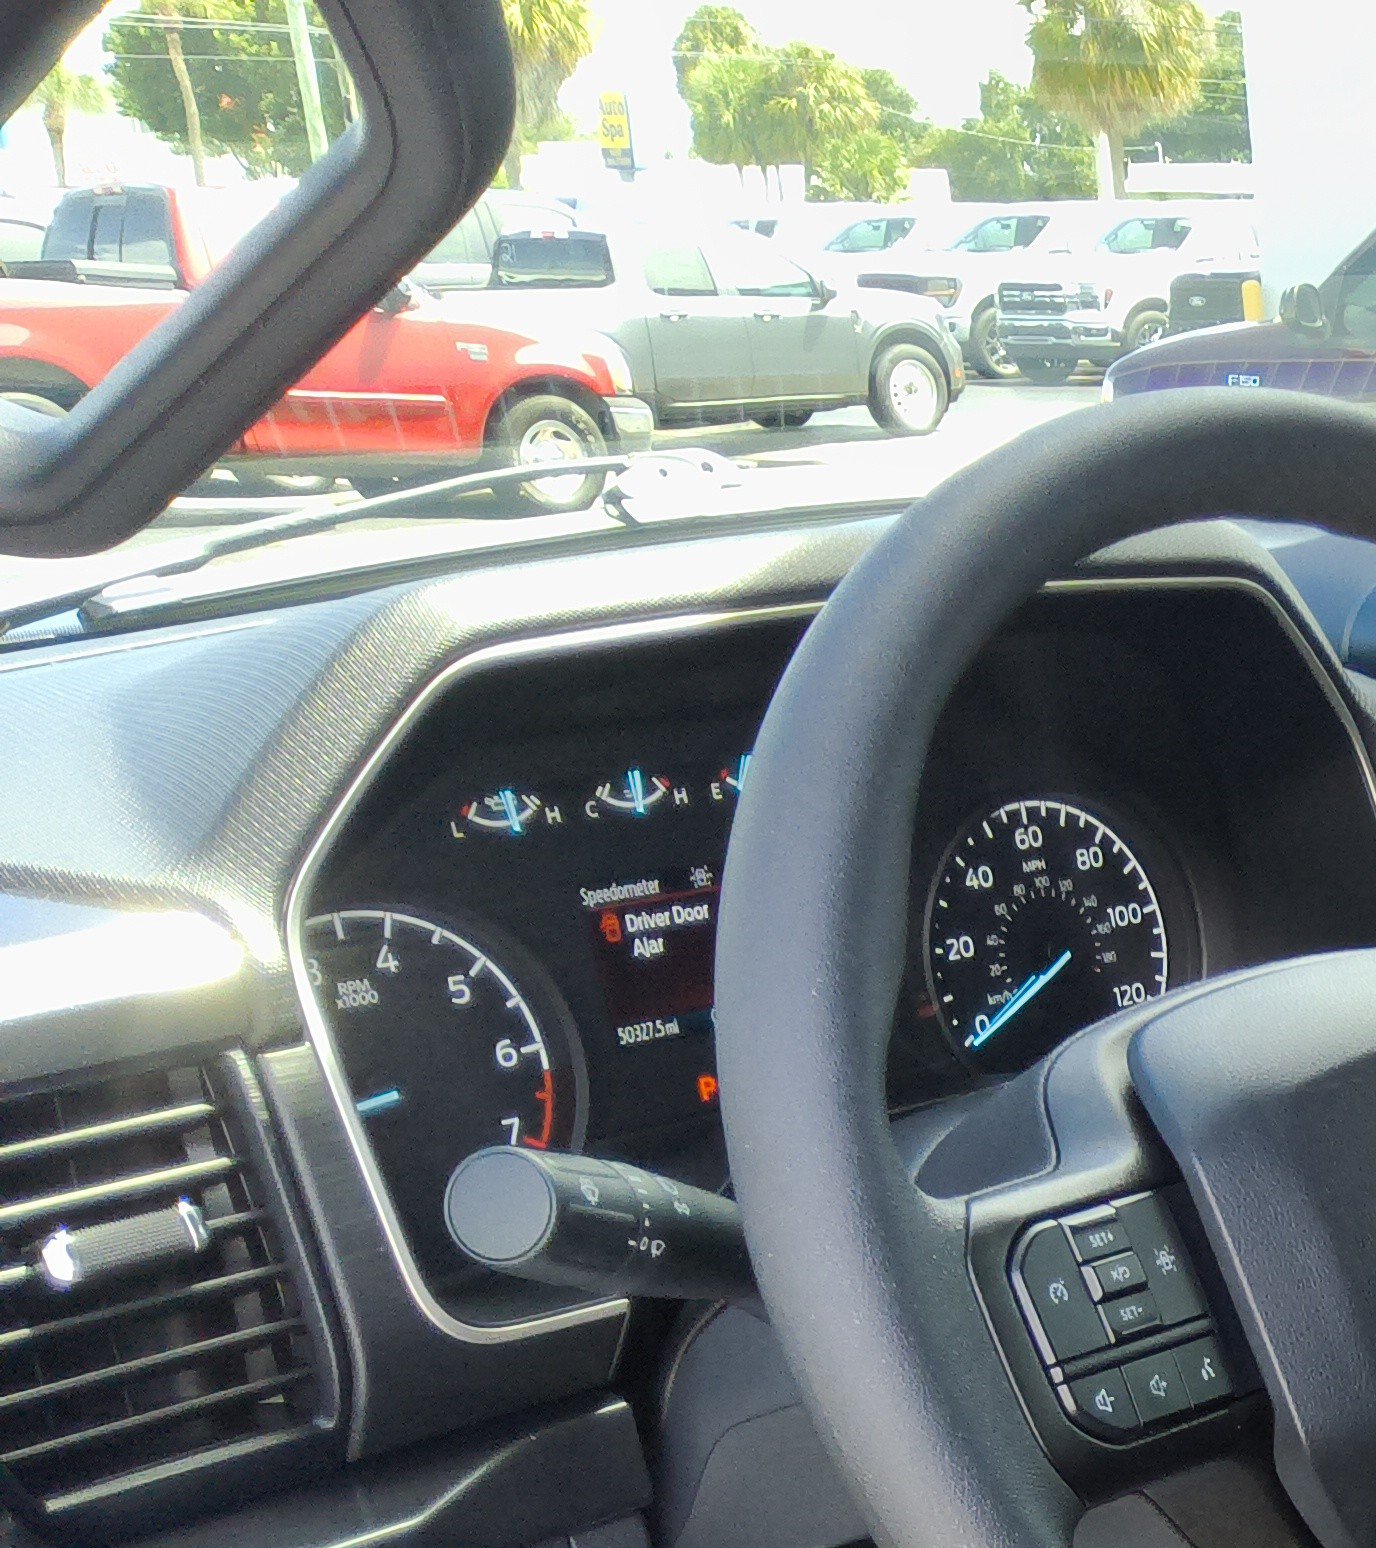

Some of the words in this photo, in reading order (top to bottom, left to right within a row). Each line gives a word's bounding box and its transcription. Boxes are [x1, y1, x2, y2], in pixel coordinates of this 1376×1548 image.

[602, 118, 624, 142] Spa
[674, 787, 688, 805] H
[711, 783, 723, 800] E
[546, 807, 561, 825] H
[585, 801, 599, 819] C
[1014, 825, 1043, 850] 60
[1022, 858, 1047, 873] MPH
[1075, 846, 1104, 871] 80
[965, 865, 994, 890] 40
[1034, 876, 1050, 890] 100
[579, 878, 661, 907] Speedometer
[625, 910, 671, 933] Driver
[671, 904, 710, 926] Door
[1106, 902, 1142, 928] 100
[376, 944, 400, 973] 4
[633, 936, 665, 958] Ajar
[945, 935, 975, 961] 20
[337, 978, 371, 996] RPM
[447, 975, 471, 1005] 5
[1113, 982, 1146, 1008] 120
[617, 1019, 665, 1046] 50327.5
[495, 1039, 518, 1067] 6
[697, 1074, 717, 1103] P
[500, 1117, 521, 1147] 7
